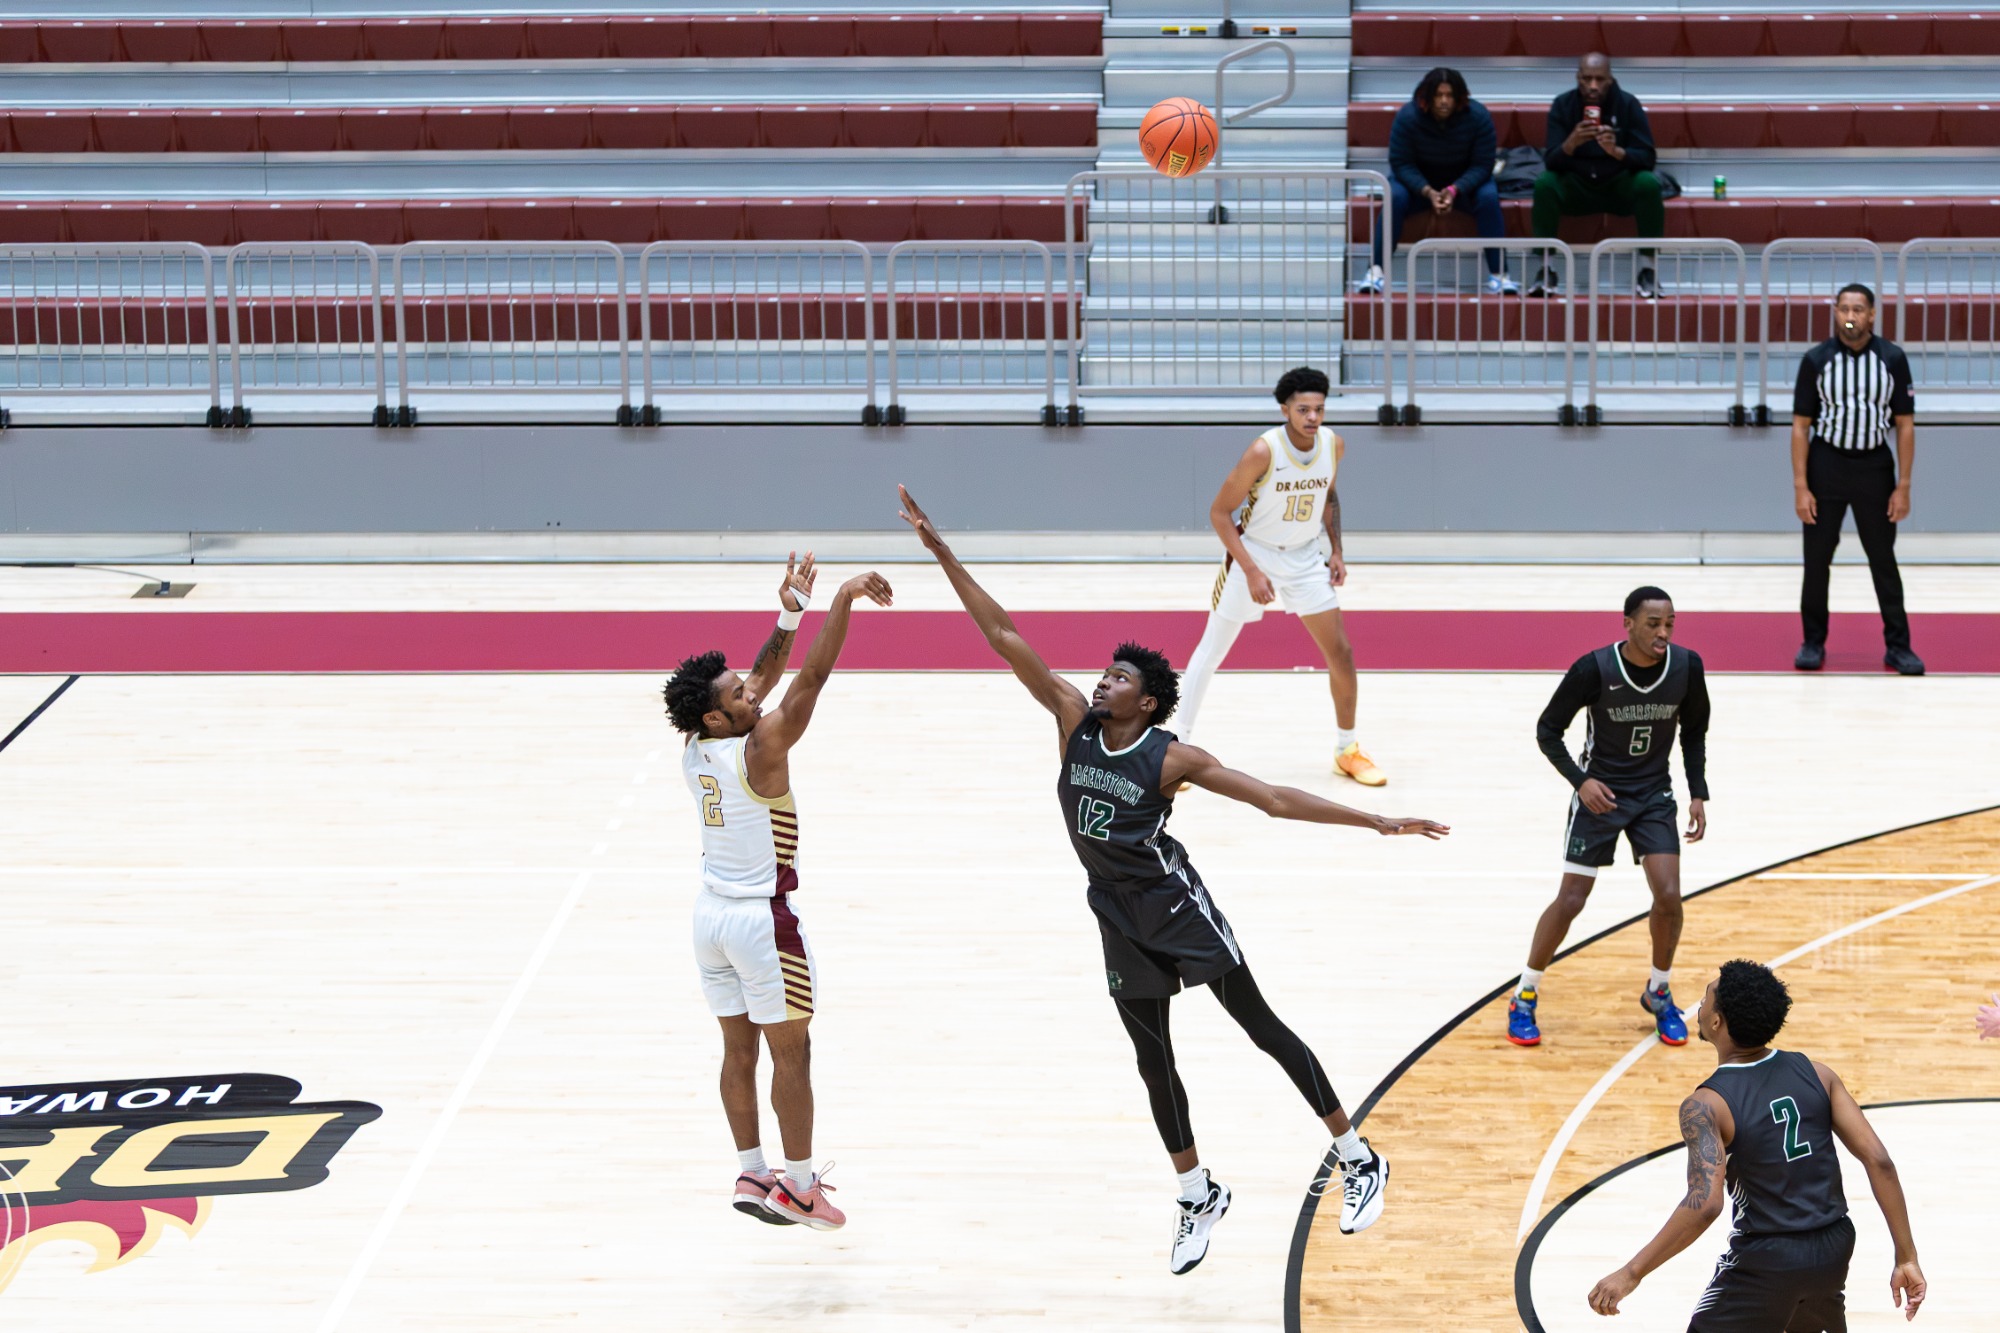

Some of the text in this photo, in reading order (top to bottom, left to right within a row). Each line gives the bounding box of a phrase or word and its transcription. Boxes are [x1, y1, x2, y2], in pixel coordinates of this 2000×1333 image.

[1275, 477, 1328, 492] DRAGONS
[1282, 494, 1315, 522] 15
[1606, 703, 1679, 722] HAGERSTOW
[1629, 726, 1652, 757] 5
[698, 774, 725, 827] 2
[1070, 763, 1145, 807] HAGERSTOWN
[1077, 795, 1116, 842] 12
[1769, 1095, 1813, 1163] 2
